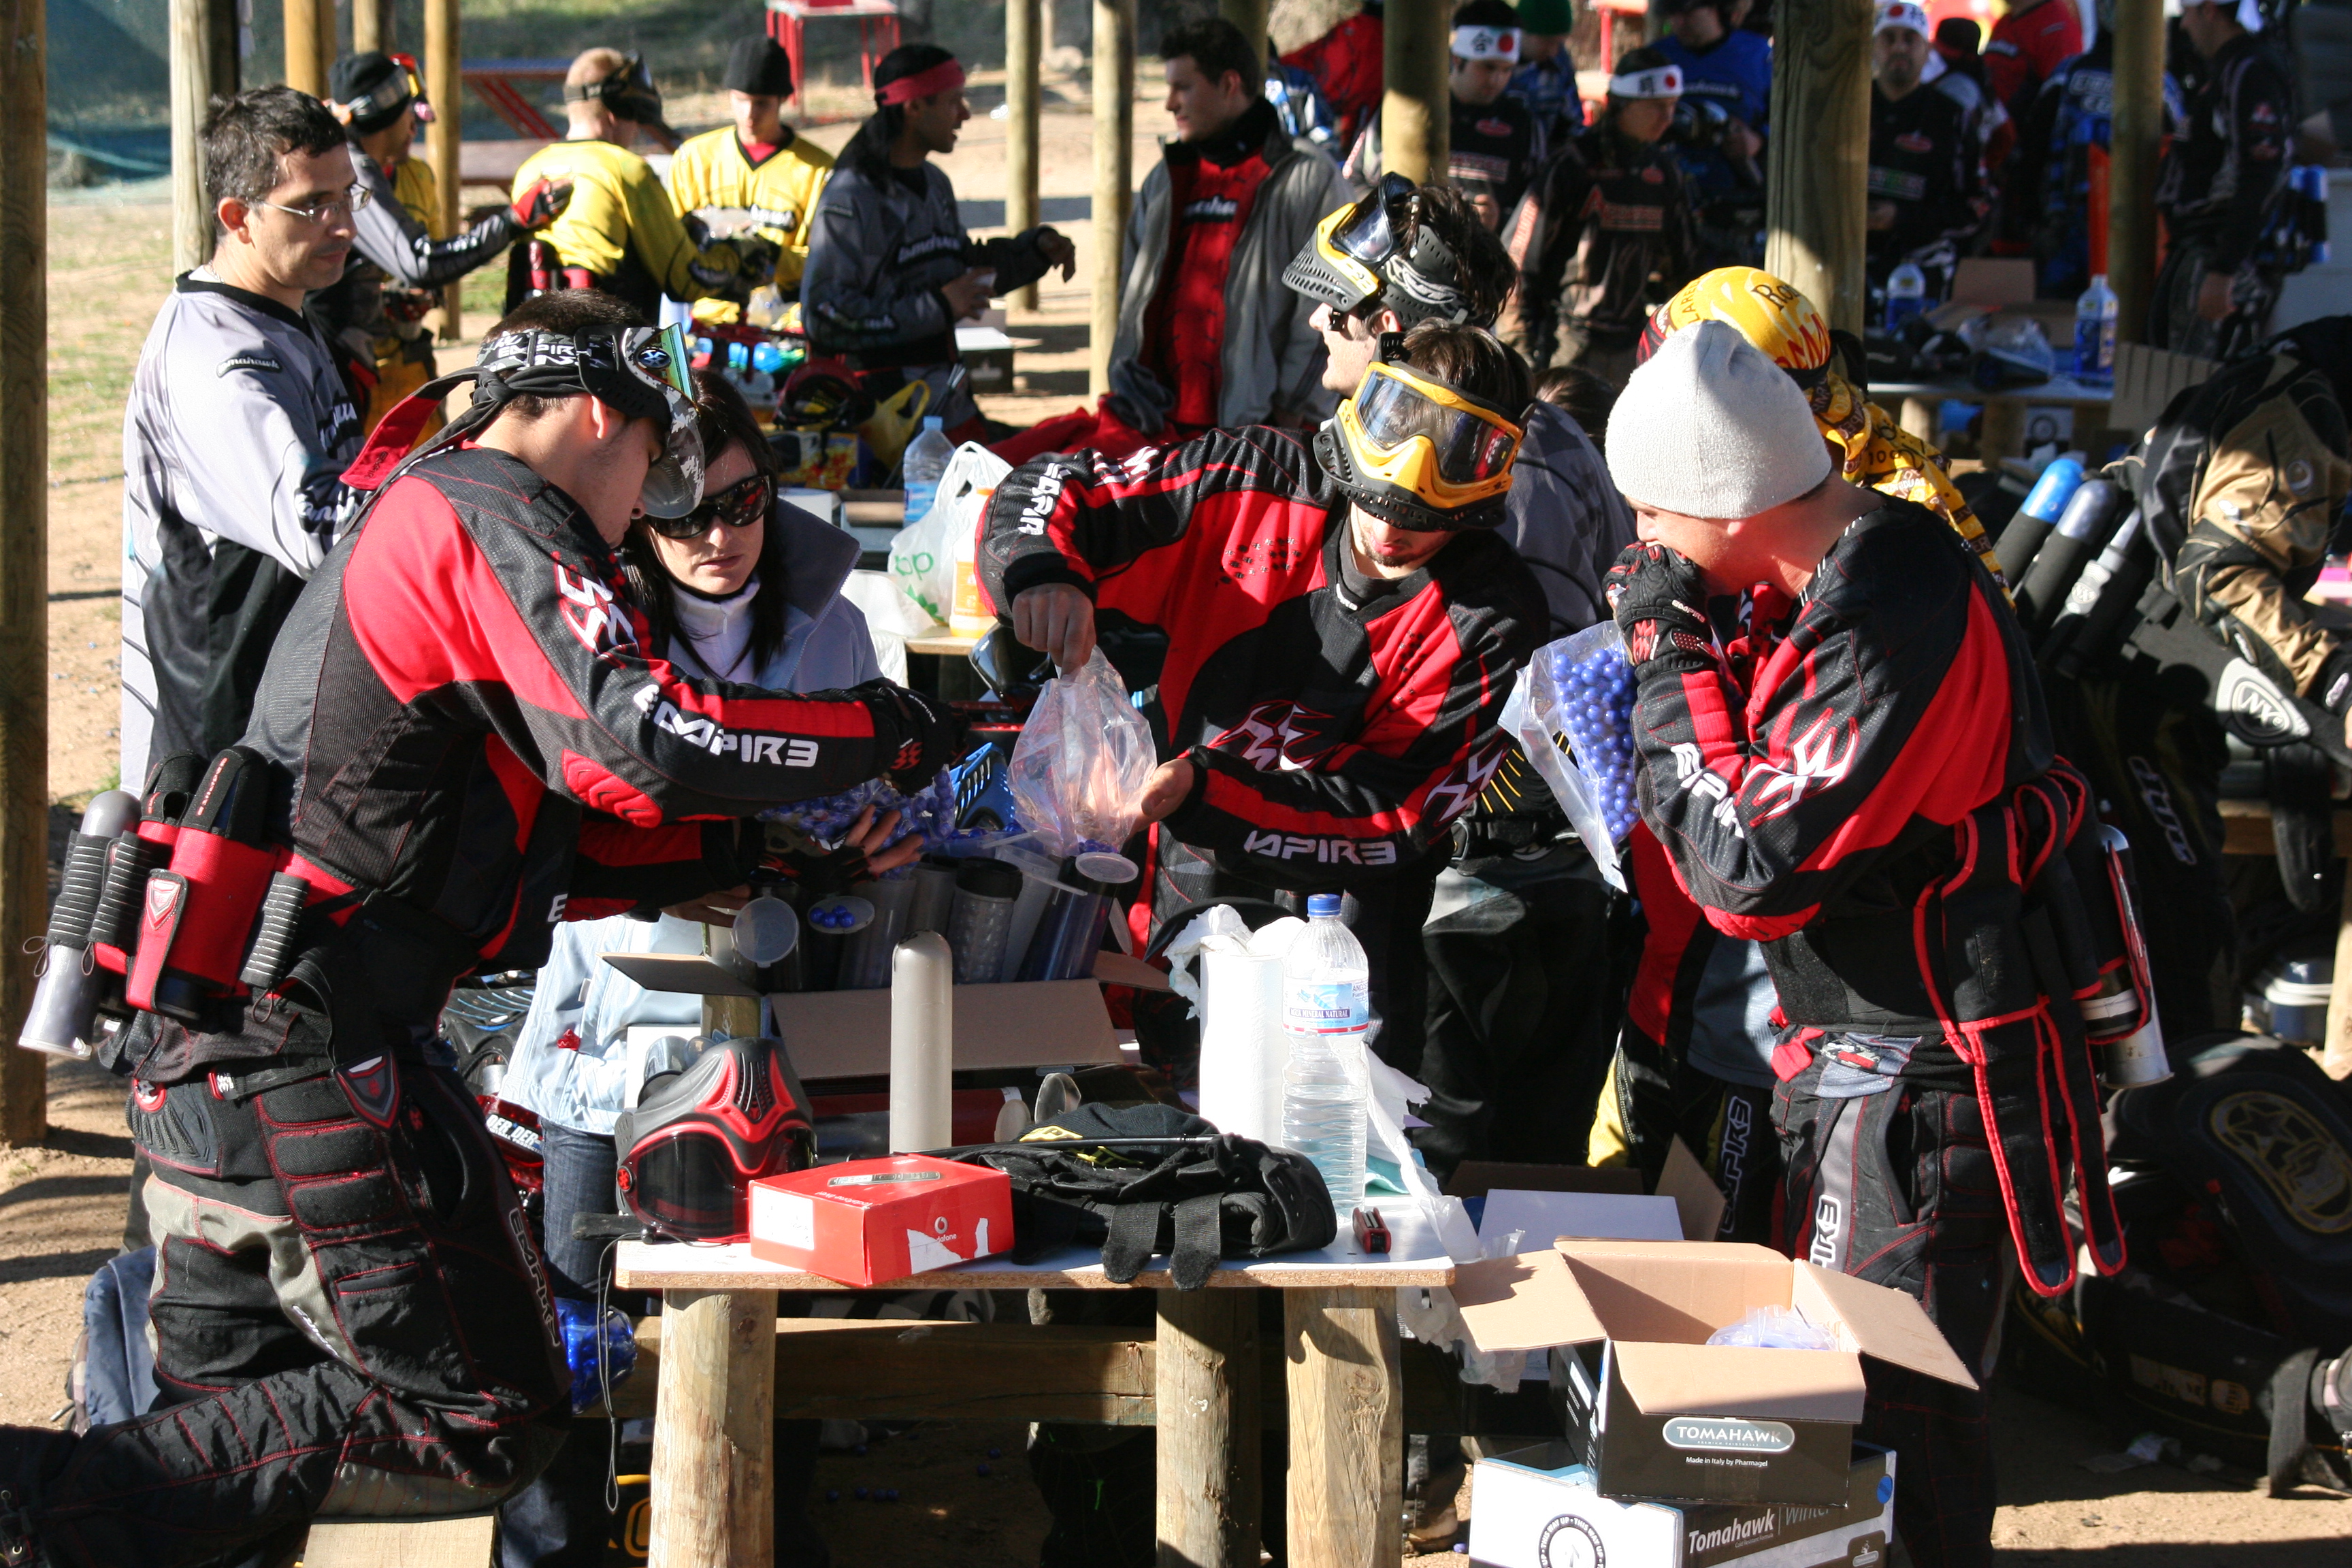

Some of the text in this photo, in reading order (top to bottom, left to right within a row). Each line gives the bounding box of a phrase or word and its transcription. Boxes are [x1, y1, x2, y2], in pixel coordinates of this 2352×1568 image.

[1325, 1009, 1348, 1018] NATURAL
[1676, 1426, 1781, 1443] TOMAHAWK
[1712, 1458, 1725, 1466] Italy
[1735, 1458, 1768, 1468] Pharmagel
[1559, 1516, 1570, 1524] UP
[1573, 1517, 1589, 1531] THIS
[1587, 1527, 1601, 1545] WAY
[1688, 1508, 1776, 1554] Tomahawk
